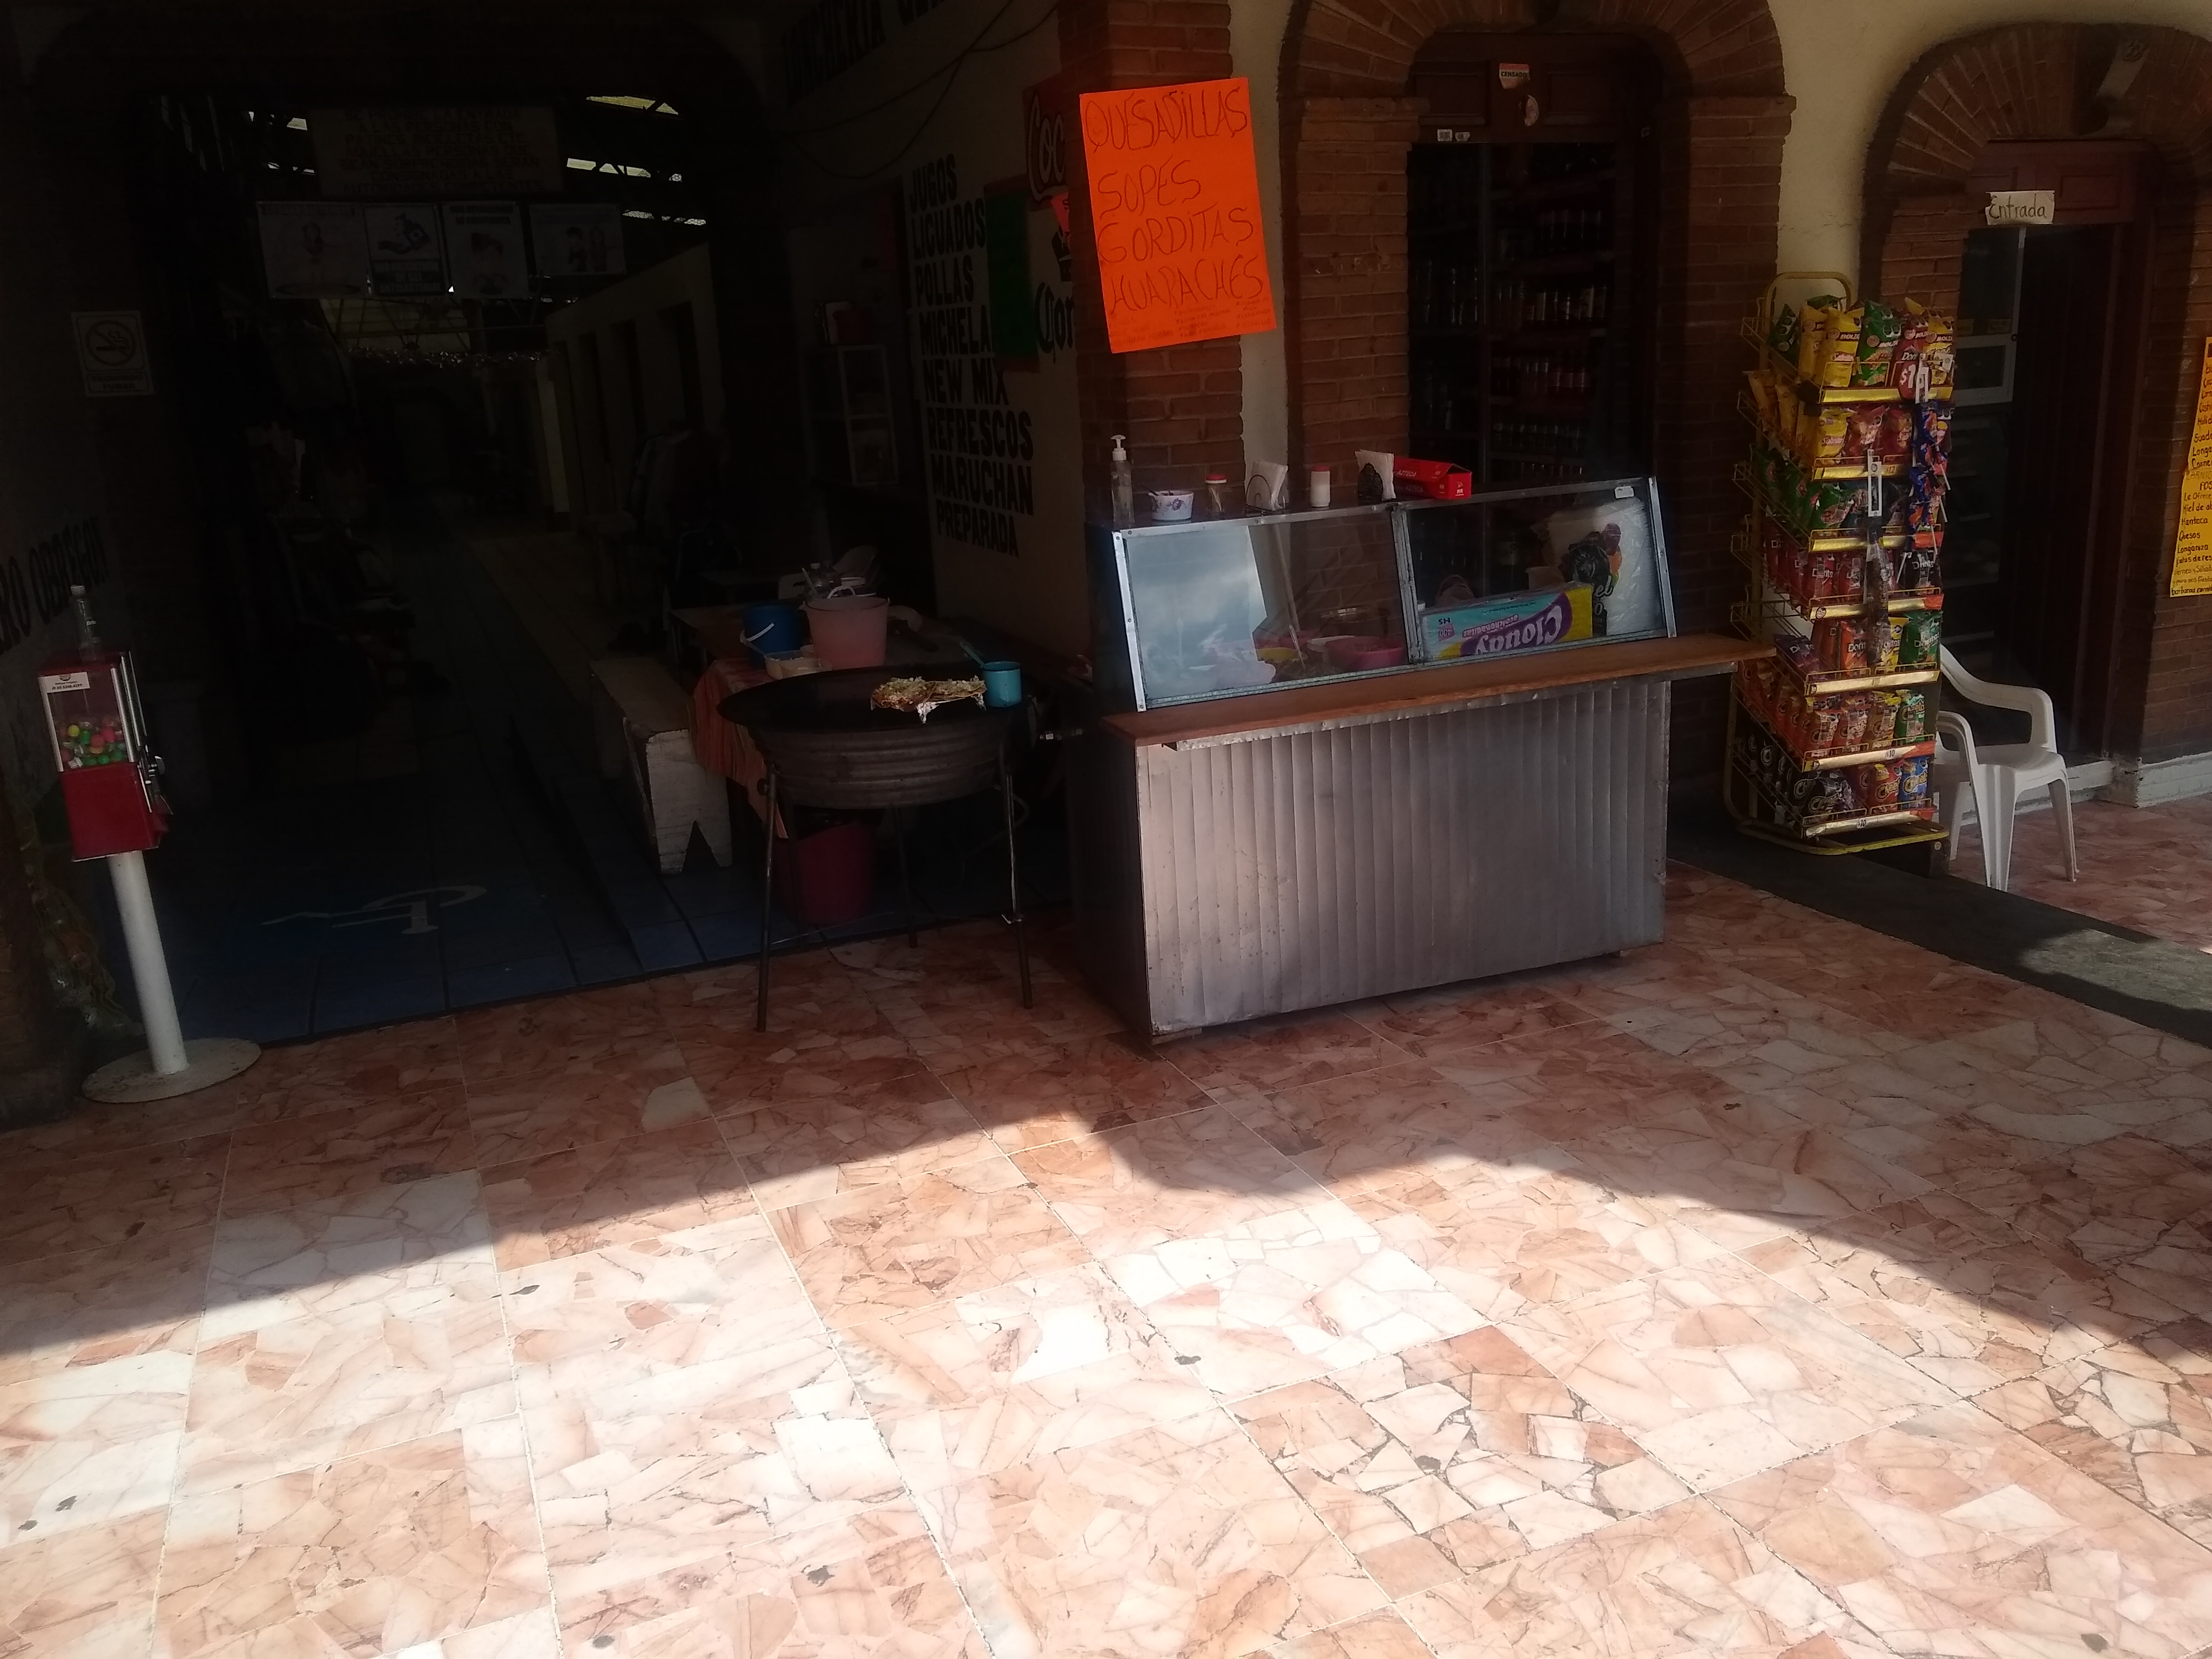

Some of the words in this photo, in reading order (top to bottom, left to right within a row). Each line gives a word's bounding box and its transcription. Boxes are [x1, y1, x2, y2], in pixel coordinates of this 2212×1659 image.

[1028, 91, 1065, 202] Coc
[910, 153, 957, 214] JUGOS
[1098, 155, 1202, 220] SOPES
[1988, 193, 2047, 219] Entrada
[912, 198, 986, 260] LICUADOS
[1097, 203, 1253, 264] GORDITAS
[915, 254, 974, 307] POLLAS
[1110, 254, 1263, 315] HUARACHES
[919, 304, 992, 356] MICHELA
[1035, 282, 1074, 364] Cor
[922, 359, 962, 404] NEW
[971, 358, 1009, 406] MIX
[927, 407, 1034, 461] REFRESCOS
[930, 453, 1034, 515] MARUCHAN
[935, 498, 1020, 558] PREPARADA
[1438, 617, 1451, 625] HS
[1438, 628, 1452, 638] 400
